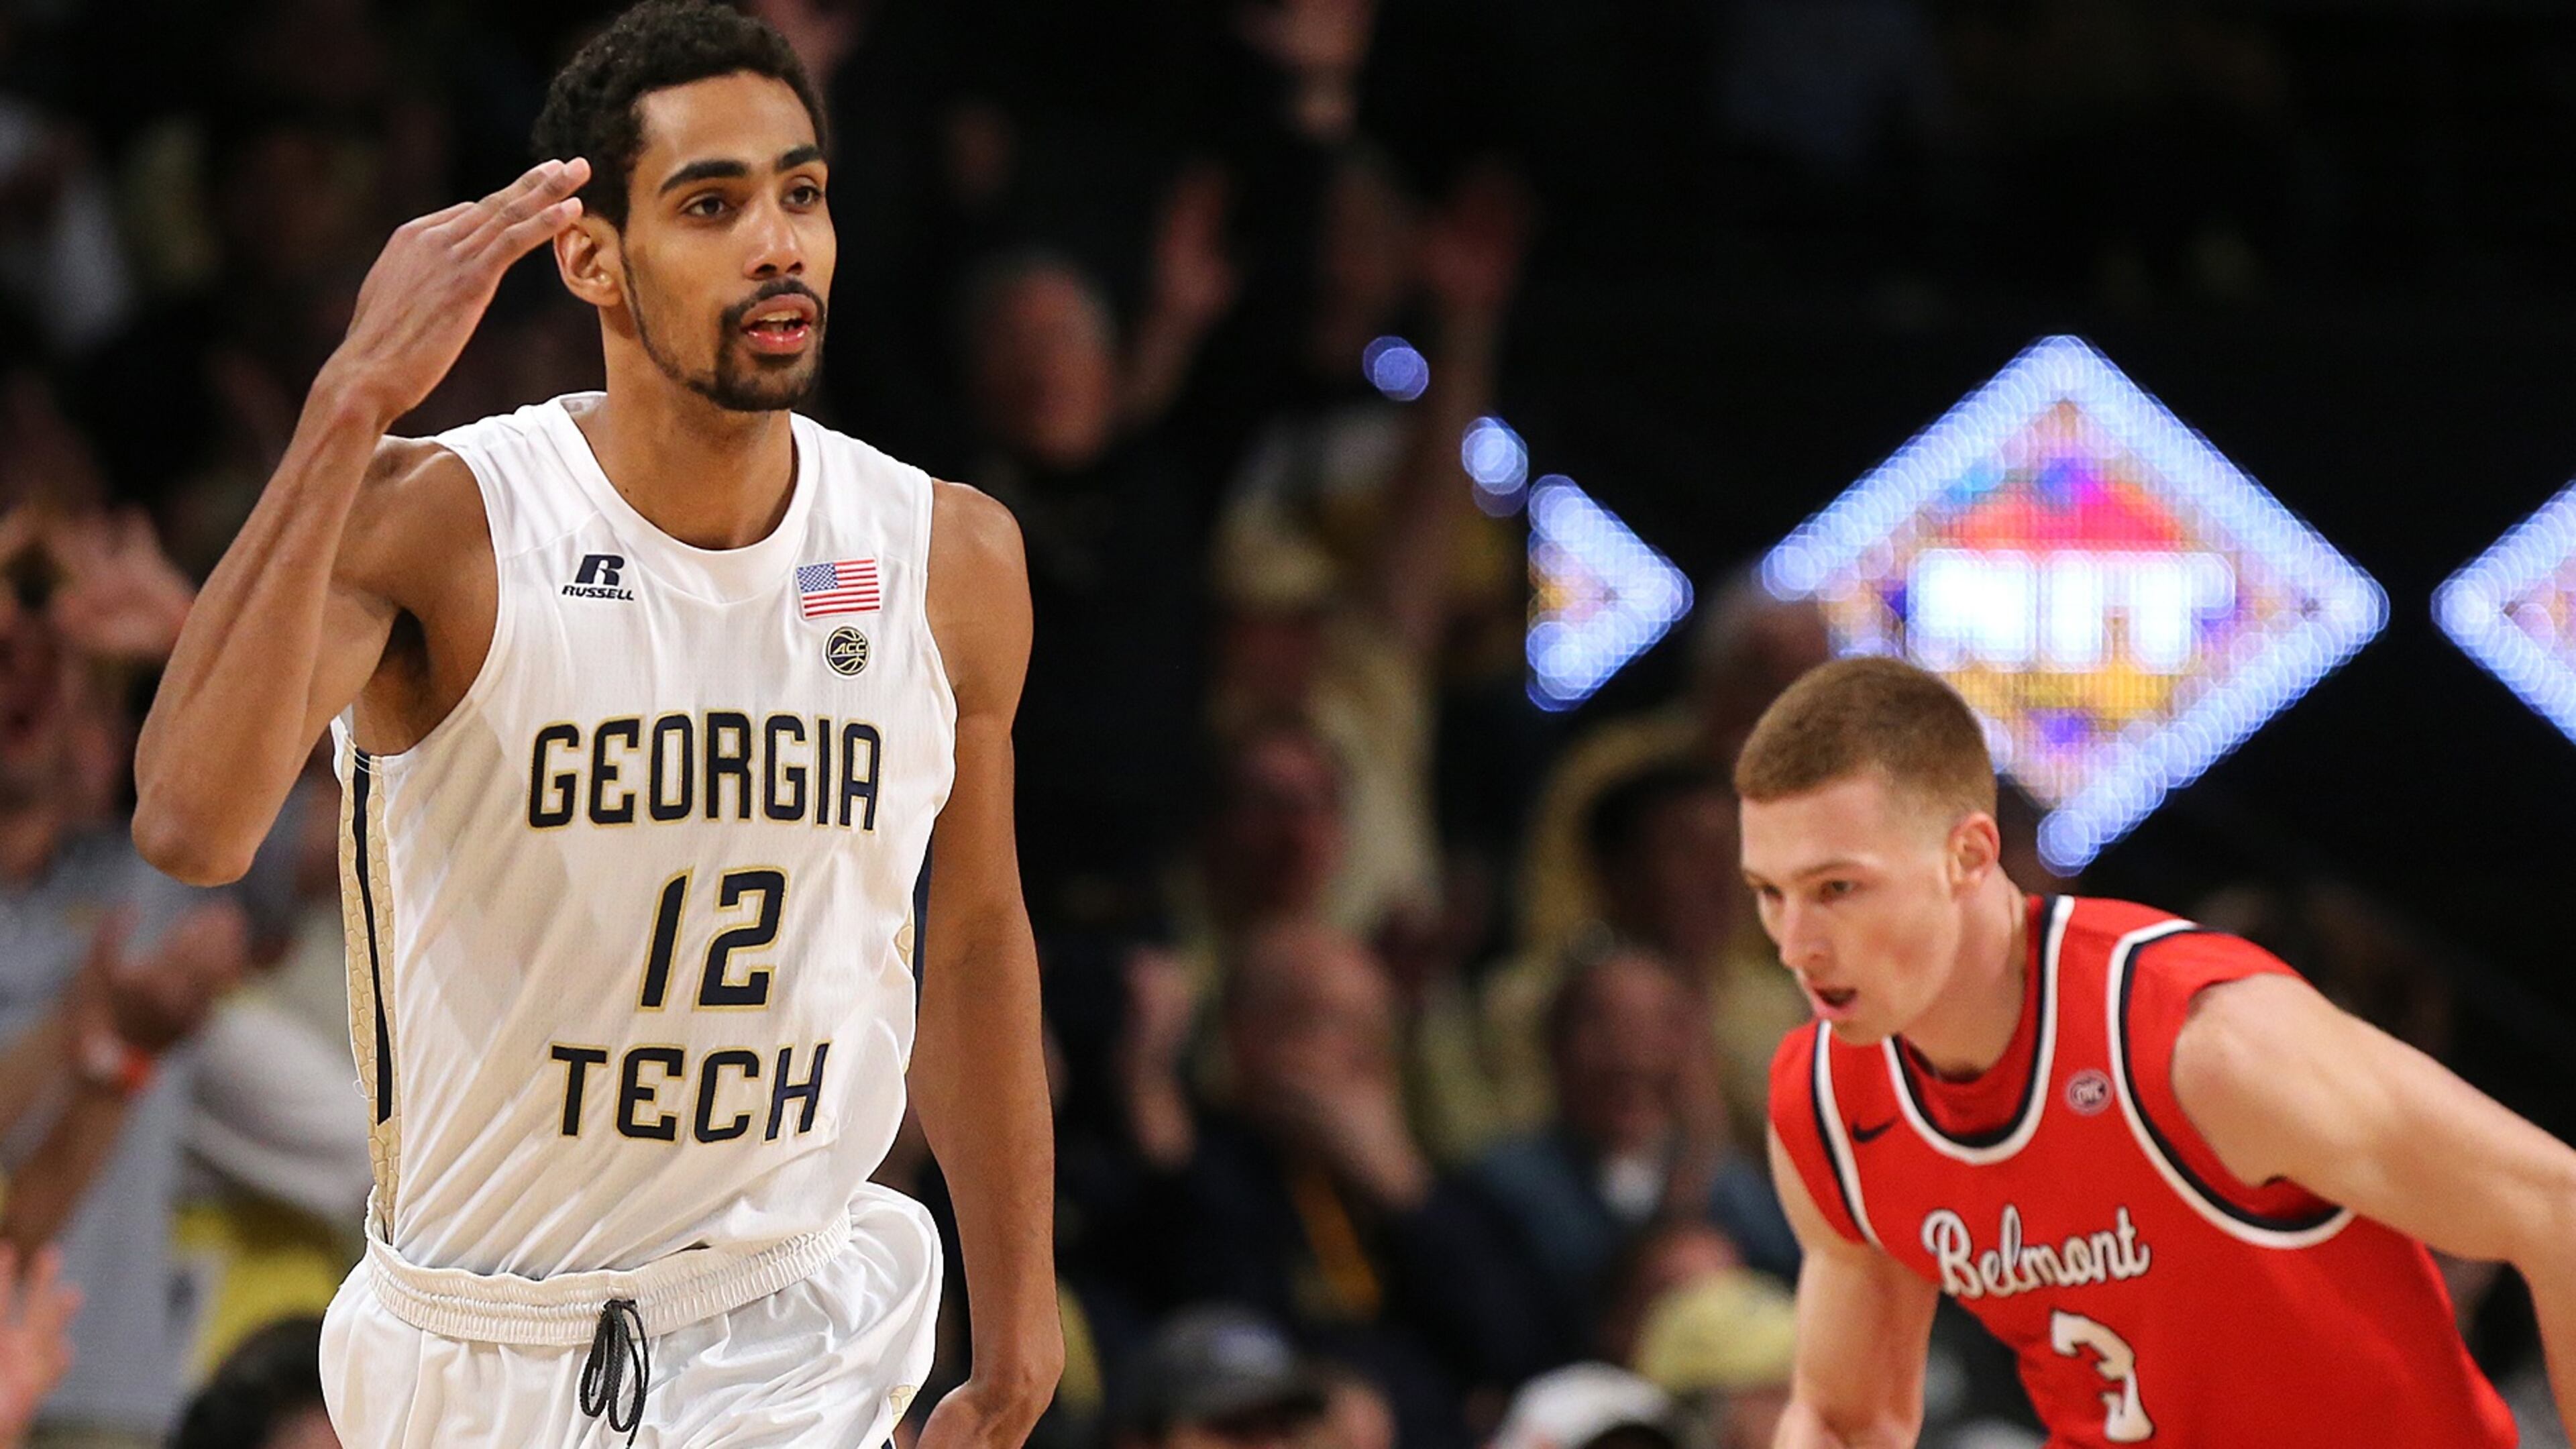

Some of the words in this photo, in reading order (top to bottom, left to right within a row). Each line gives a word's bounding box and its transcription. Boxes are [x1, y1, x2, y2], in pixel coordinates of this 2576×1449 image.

[561, 585, 635, 601] RUSSELL
[833, 643, 866, 655] ACC
[527, 709, 883, 833] GEORGIA
[635, 864, 790, 1013] 12
[548, 1039, 833, 1146] TECH
[1921, 1203, 2151, 1299] Belmont
[2049, 1308, 2154, 1444] 3
